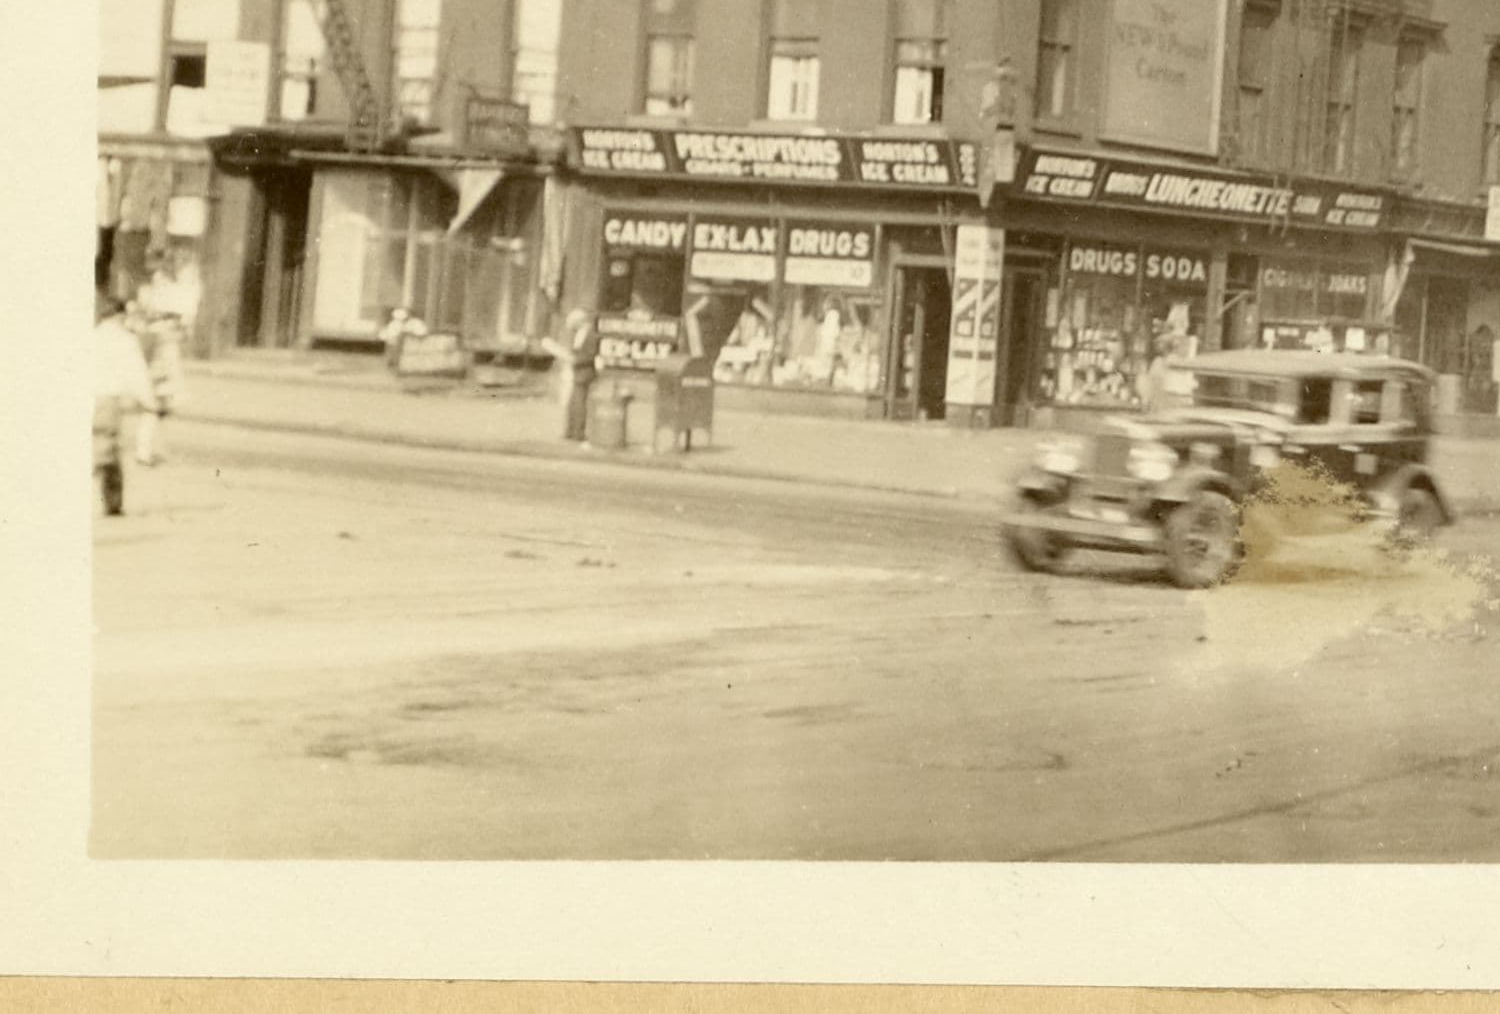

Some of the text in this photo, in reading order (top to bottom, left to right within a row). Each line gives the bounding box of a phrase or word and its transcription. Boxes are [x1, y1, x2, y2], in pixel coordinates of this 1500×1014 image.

[583, 150, 666, 171] ICE CREAM
[674, 134, 843, 163] PRESCRIPTIONS
[861, 162, 949, 184] ICE CREAM
[1048, 178, 1094, 198] CREAM
[1146, 174, 1295, 215] LUNCHEONETTE
[604, 219, 686, 247] CANDY
[790, 230, 869, 257] DRUGS
[1070, 247, 1206, 280] DRUGS SODA
